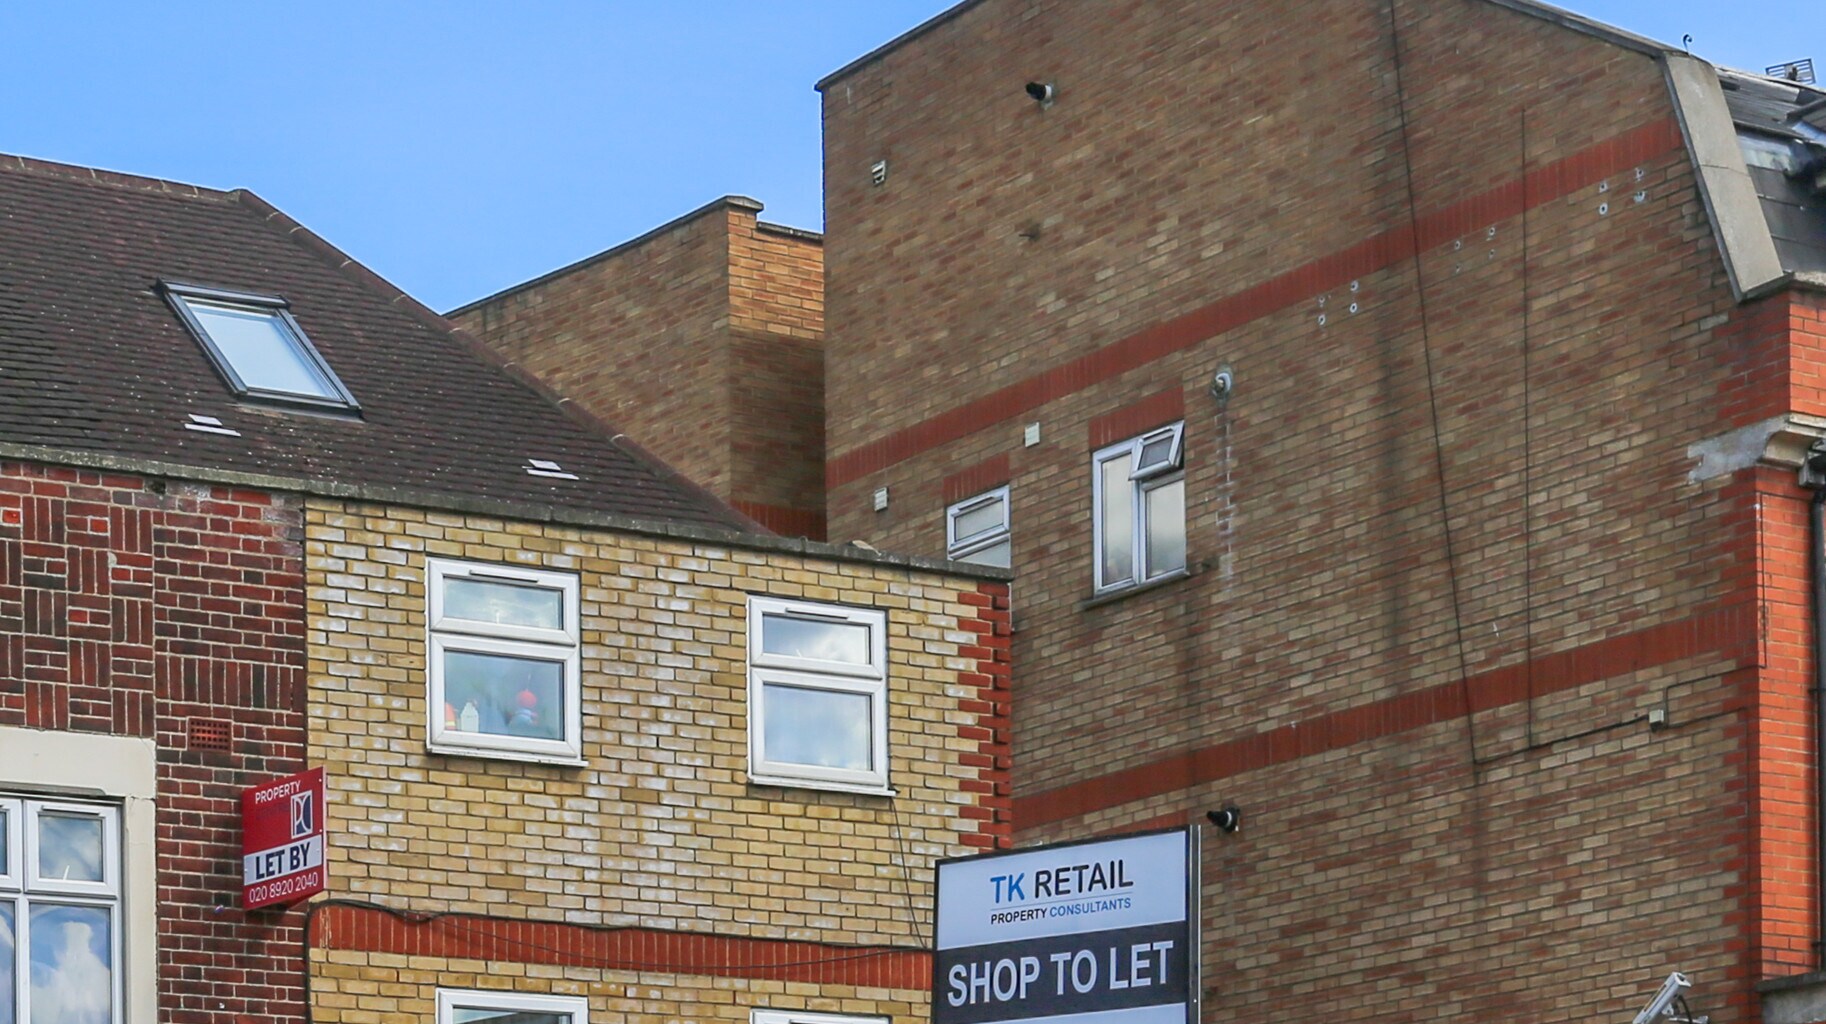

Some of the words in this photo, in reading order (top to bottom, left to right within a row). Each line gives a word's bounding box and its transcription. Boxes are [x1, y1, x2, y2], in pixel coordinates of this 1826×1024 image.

[255, 780, 301, 804] PROPERTY
[255, 849, 285, 880] LET
[290, 842, 310, 871] BY
[249, 886, 268, 903] 020
[269, 879, 293, 898] 8920
[295, 872, 319, 891] 2040
[990, 872, 1026, 904] TK
[1034, 859, 1134, 899] RETAIL
[990, 907, 1047, 925] PROPERTY
[1049, 897, 1132, 918] CONSULTANTS
[947, 956, 1041, 1007] SHOP
[1050, 949, 1098, 996] TO
[1109, 940, 1174, 990] LET
